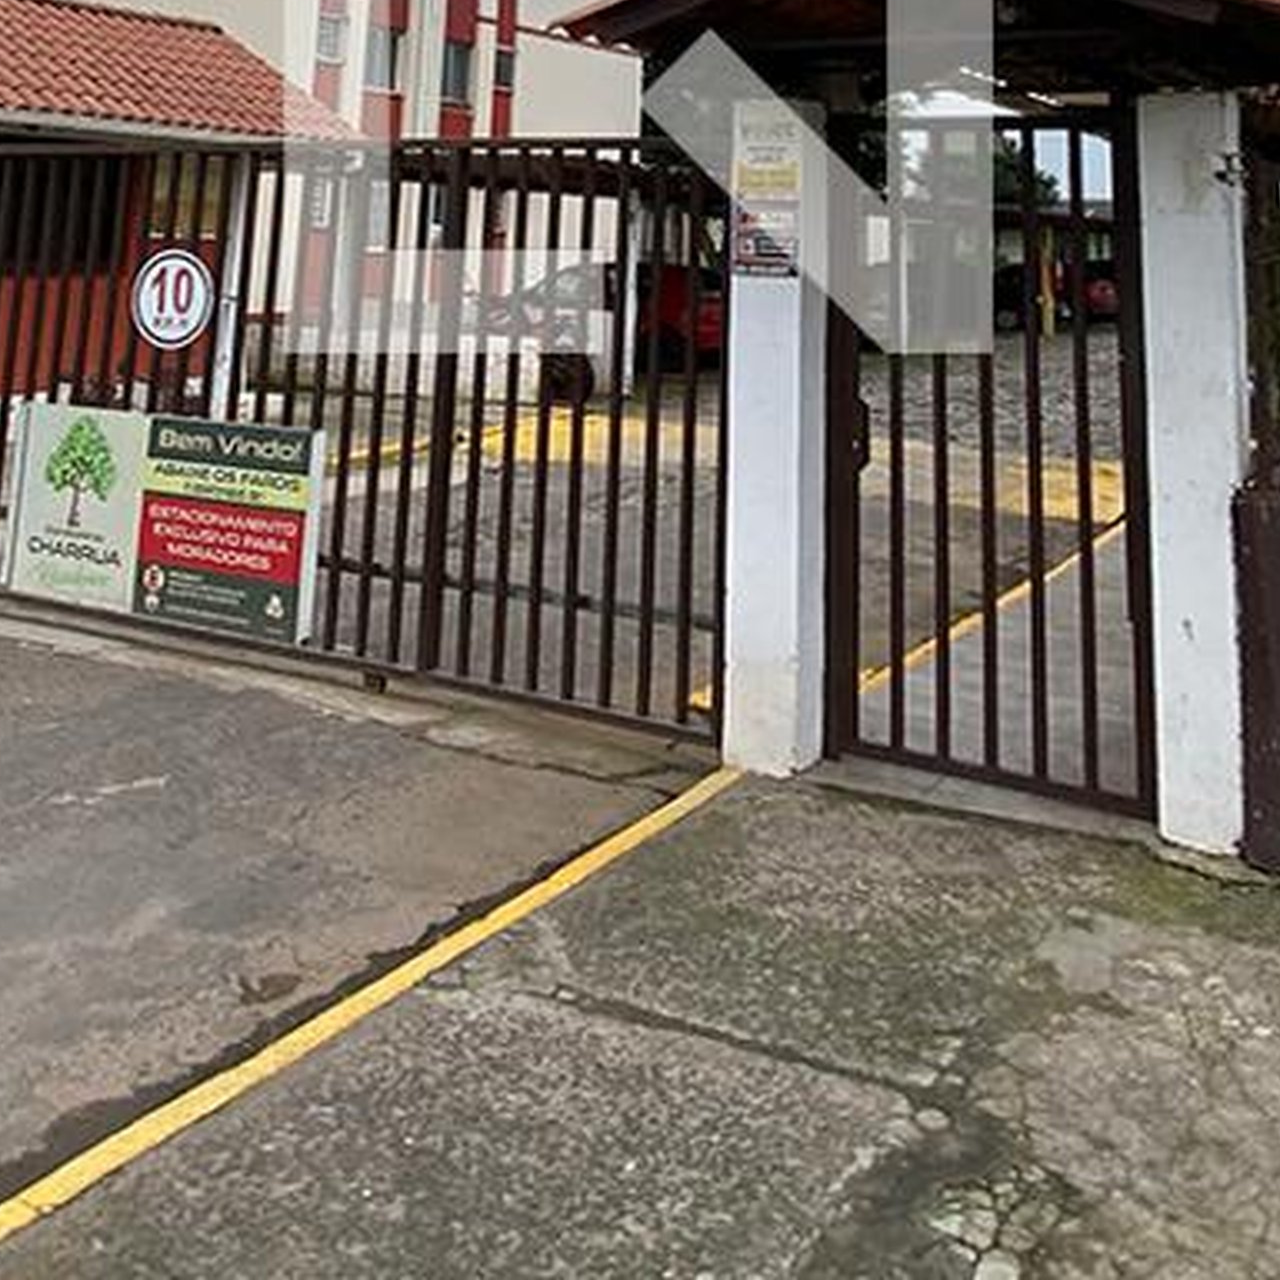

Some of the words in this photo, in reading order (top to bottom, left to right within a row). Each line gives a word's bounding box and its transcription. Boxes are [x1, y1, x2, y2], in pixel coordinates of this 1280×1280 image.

[151, 266, 194, 315] 10
[158, 428, 215, 454] Bem
[152, 521, 241, 548] EXCLUSIVO
[27, 535, 122, 568] CHARRUA
[165, 542, 272, 570] MORADORES
